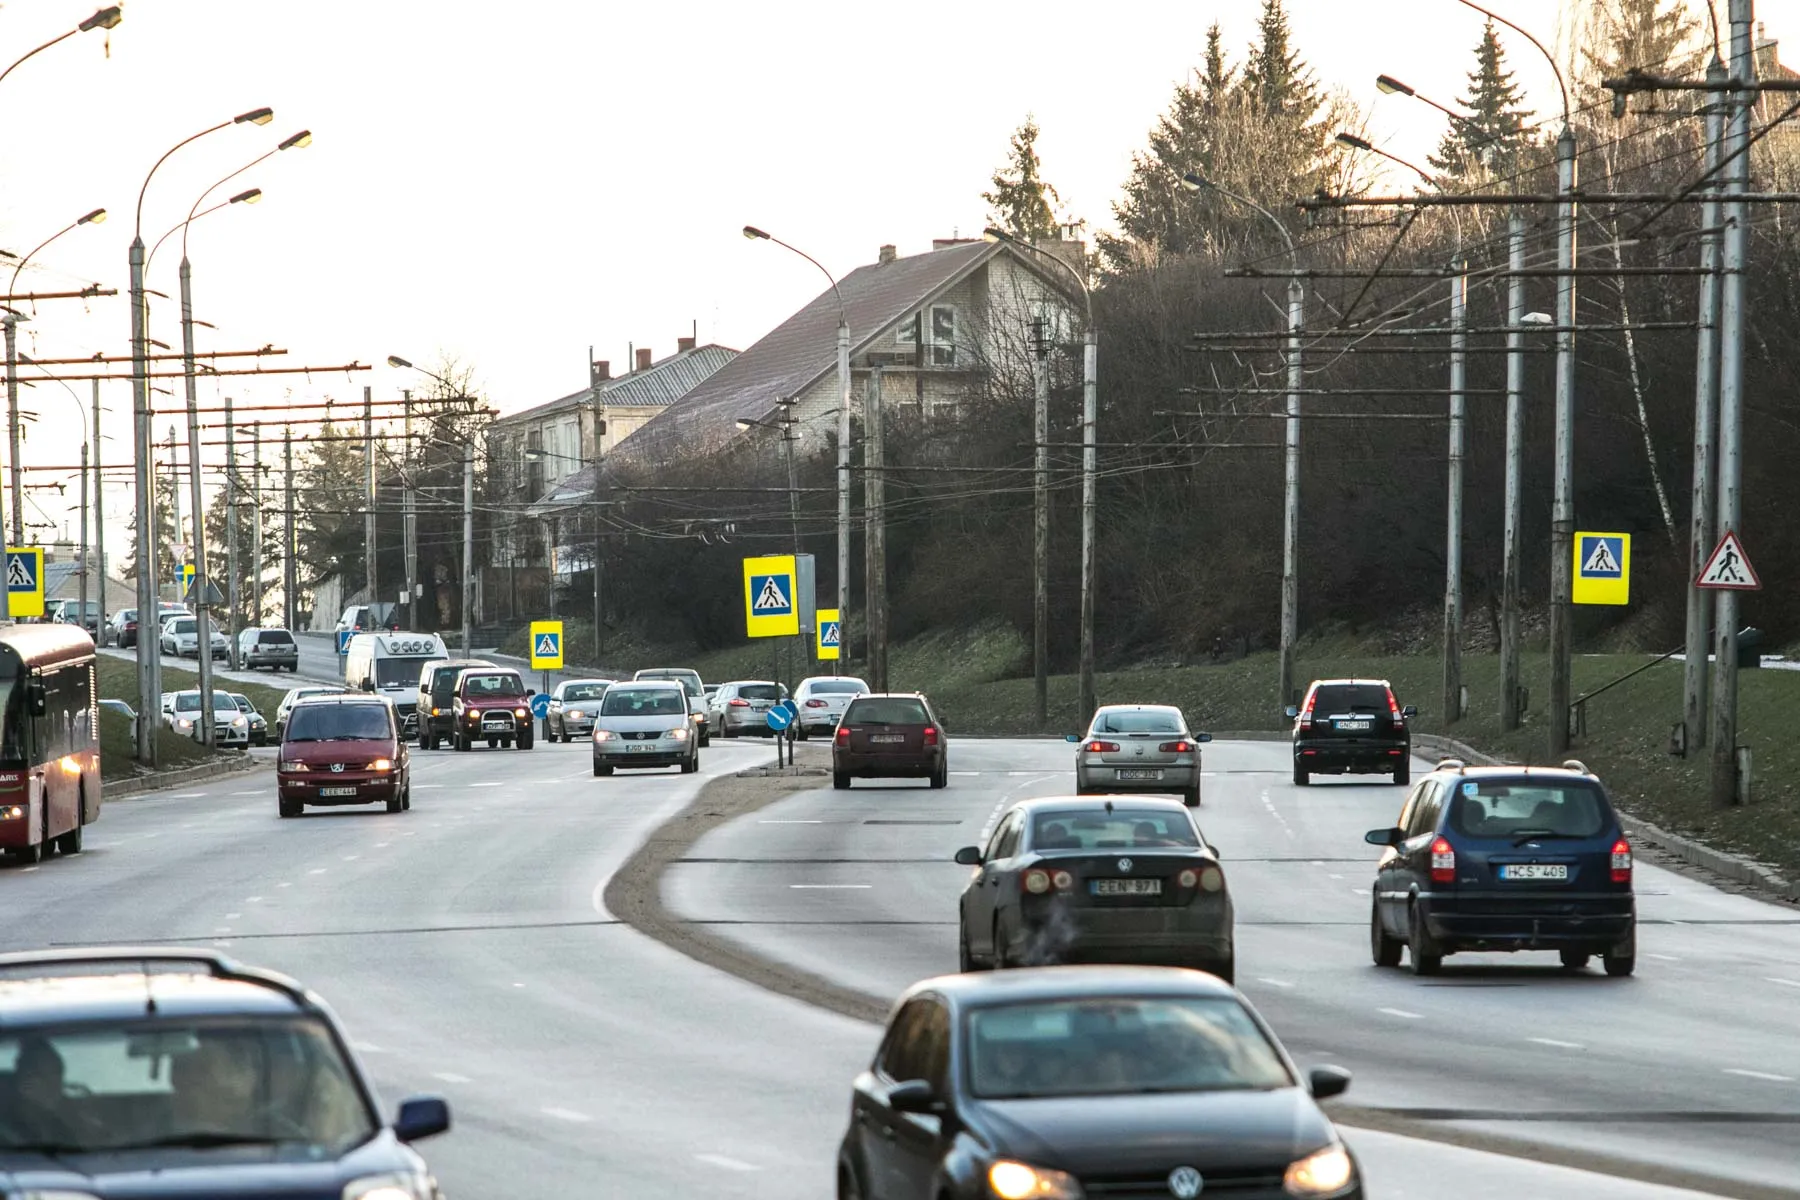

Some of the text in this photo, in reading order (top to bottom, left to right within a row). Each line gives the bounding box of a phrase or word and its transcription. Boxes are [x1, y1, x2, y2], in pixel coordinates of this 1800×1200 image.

[1508, 865, 1566, 878] HCS 409
[1099, 879, 1159, 894] EEN 971
